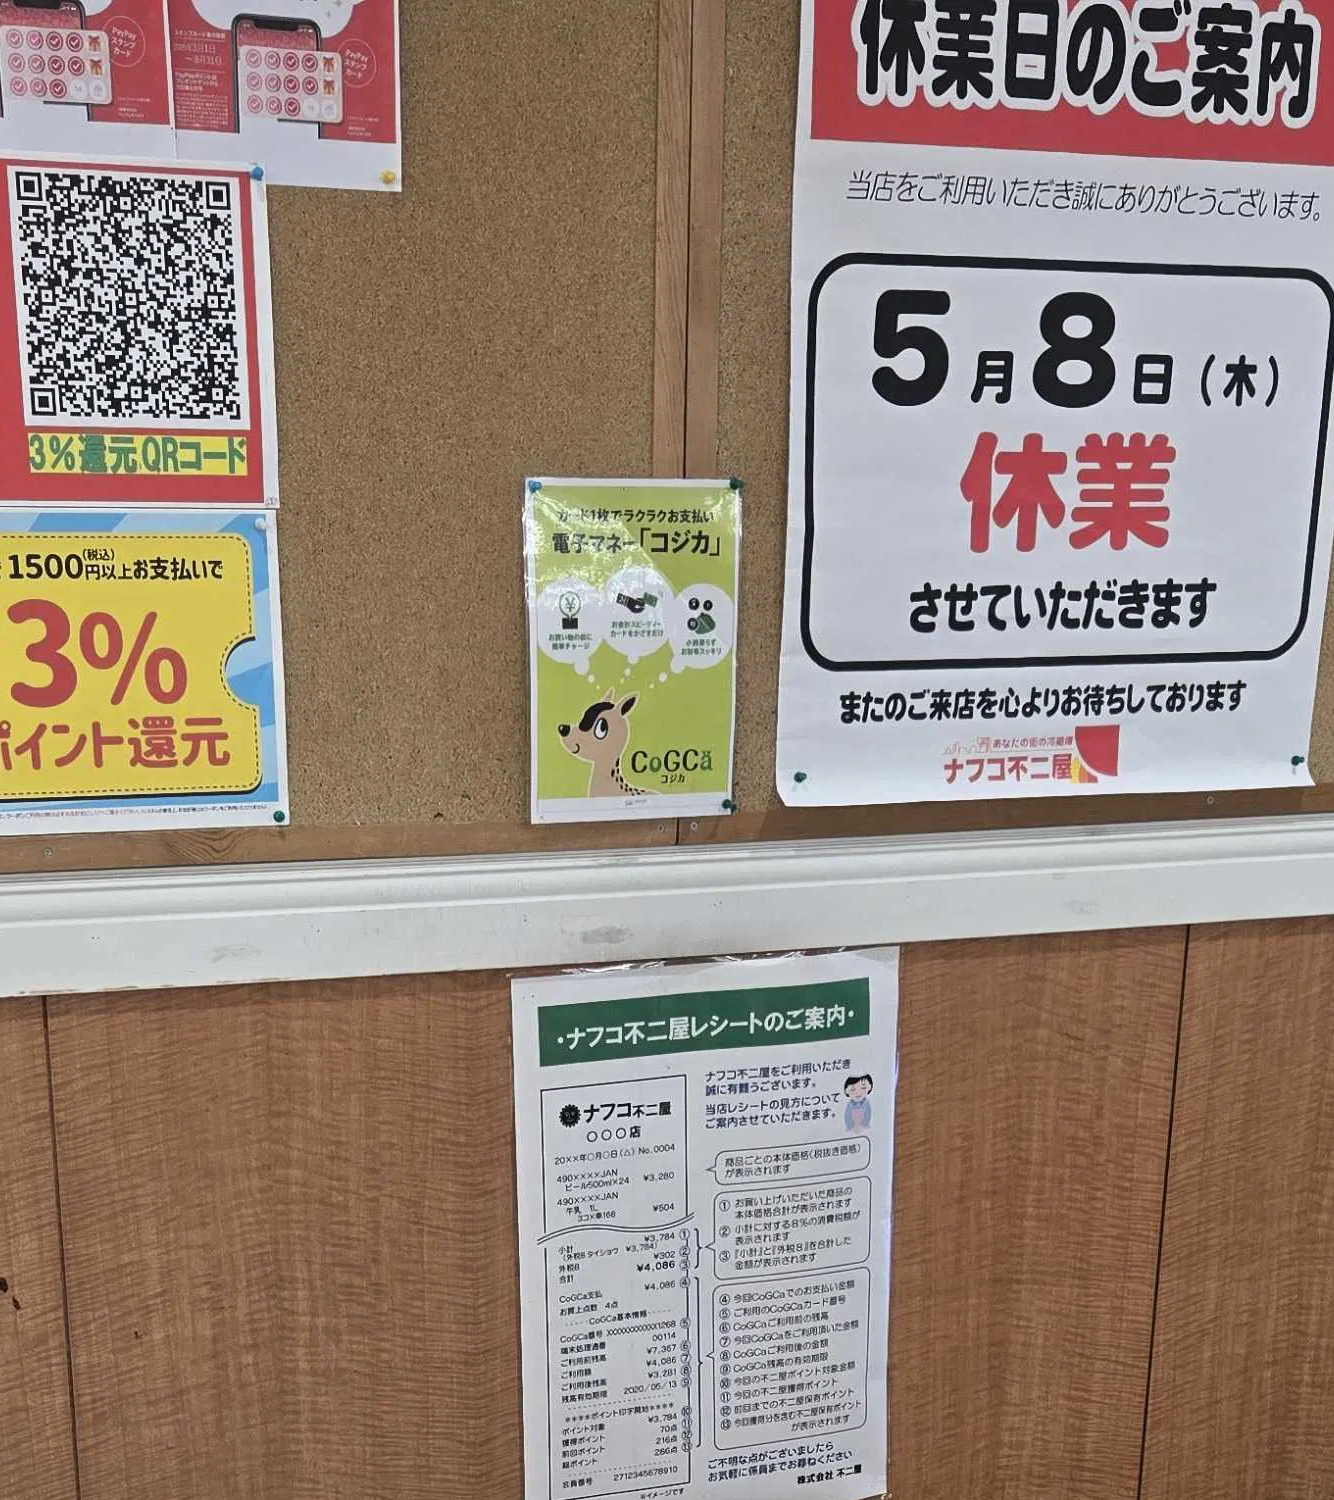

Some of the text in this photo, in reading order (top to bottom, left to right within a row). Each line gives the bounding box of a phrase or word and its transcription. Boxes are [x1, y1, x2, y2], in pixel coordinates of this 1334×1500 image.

[860, 0, 1315, 119] 休業日のご案内
[846, 170, 1323, 222] 当店をご利用いただき誠にありがとうございます。
[28, 432, 249, 476] 3%還元QRコード
[960, 431, 1176, 553] 休業
[909, 577, 1217, 633] させていただきます
[6, 598, 188, 708] 3%
[839, 679, 1247, 724] またのご来店を心よりお待ちしております
[660, 773, 686, 784] コジカ
[943, 754, 1073, 784] ナフコ不二屋
[705, 1058, 852, 1082] ナフコ不二屋をご利用いただき
[583, 1100, 672, 1123] ナフコ不二屋
[705, 1093, 840, 1116] 当店レシートの見方について
[705, 1108, 838, 1130] ご案内させていただきます。
[637, 1260, 676, 1272] ¥4,086
